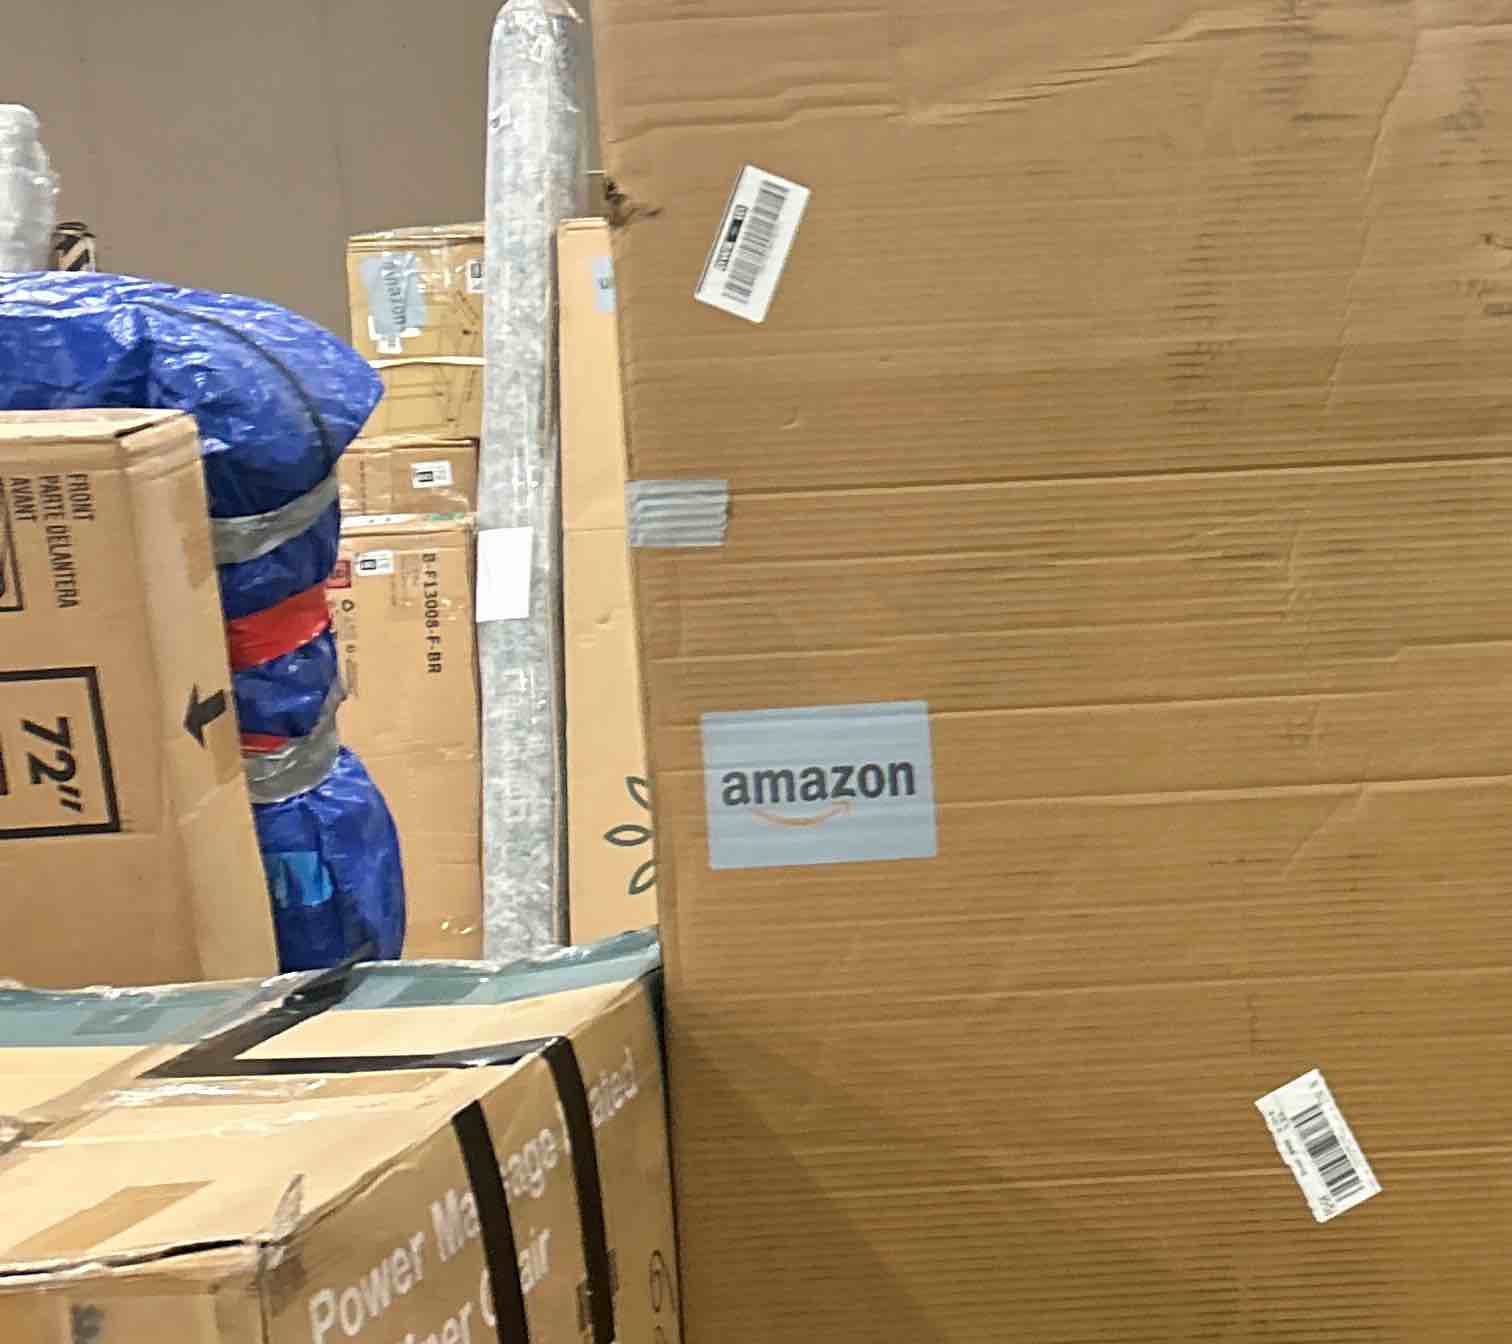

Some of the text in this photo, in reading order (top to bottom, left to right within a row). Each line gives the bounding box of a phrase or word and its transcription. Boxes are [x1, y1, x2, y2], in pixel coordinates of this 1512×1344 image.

[10, 477, 38, 521] AVANT
[66, 473, 95, 521] FRONT
[38, 474, 80, 609] PARTE DELANTERA
[720, 760, 917, 806] amazon
[431, 1127, 559, 1263] Maage
[480, 1228, 552, 1328] Cair
